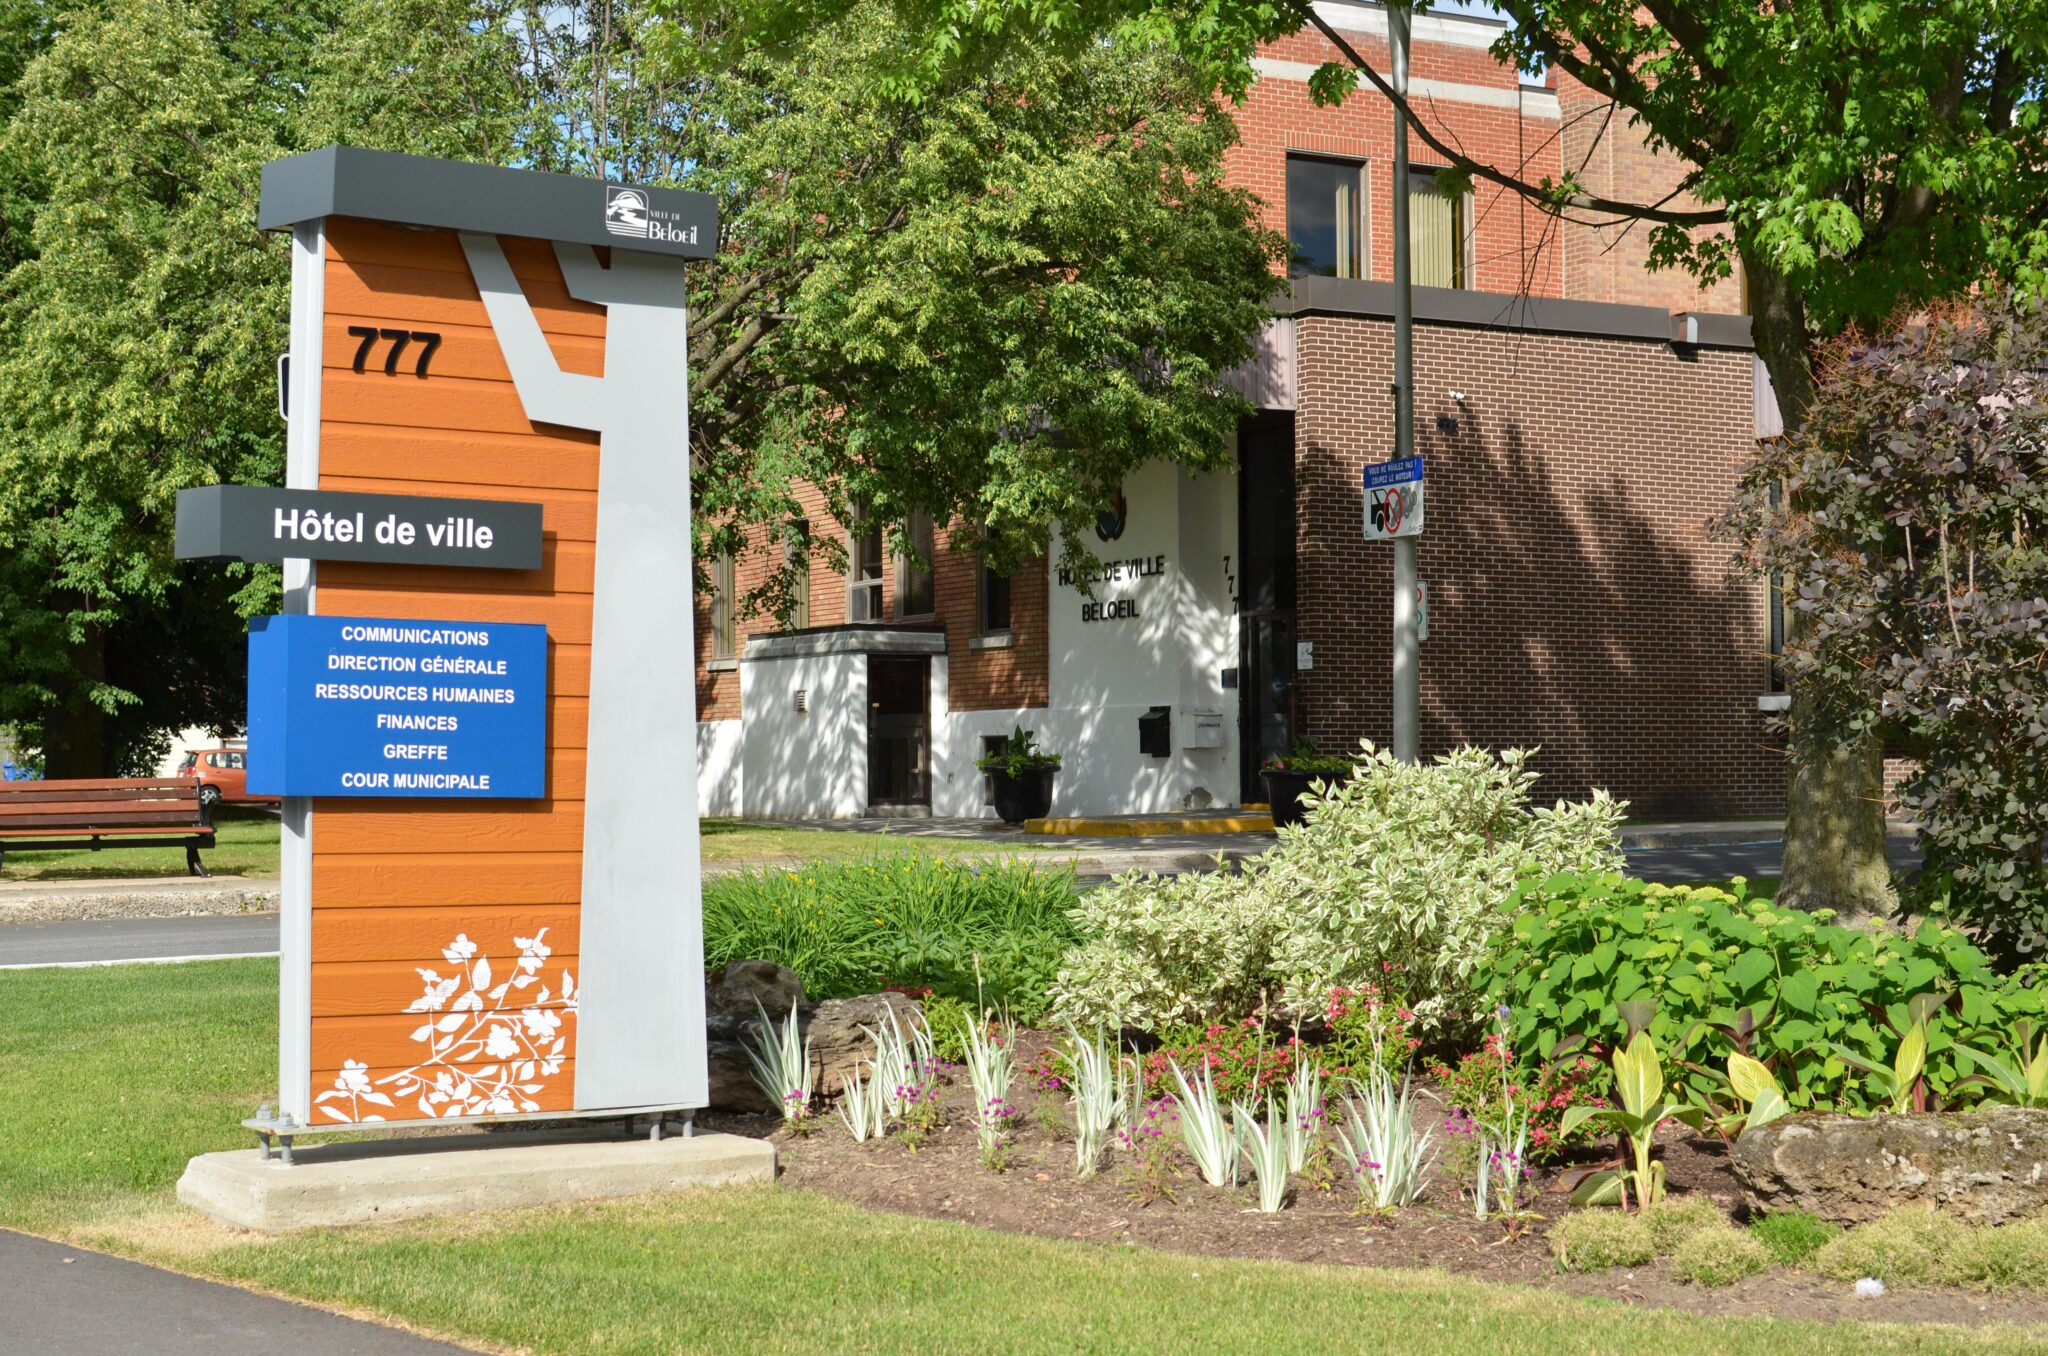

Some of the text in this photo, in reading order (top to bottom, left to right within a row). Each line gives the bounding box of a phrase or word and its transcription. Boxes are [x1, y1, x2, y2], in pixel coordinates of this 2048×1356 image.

[348, 326, 441, 378] 777
[274, 508, 494, 548] Hôtel de ville
[1104, 560, 1122, 581] DE
[1126, 555, 1165, 580] VILLE
[1082, 598, 1140, 622] BELOEIL
[341, 626, 489, 646] COMMUNICATIONS
[328, 655, 507, 675] DIRECTION GÉNÉRALE
[315, 684, 515, 704] RESSOURCES HUMAINES
[377, 714, 458, 730] FINANCES
[383, 744, 448, 760] GREFFE
[341, 773, 490, 790] COUR MUNICIPALE
